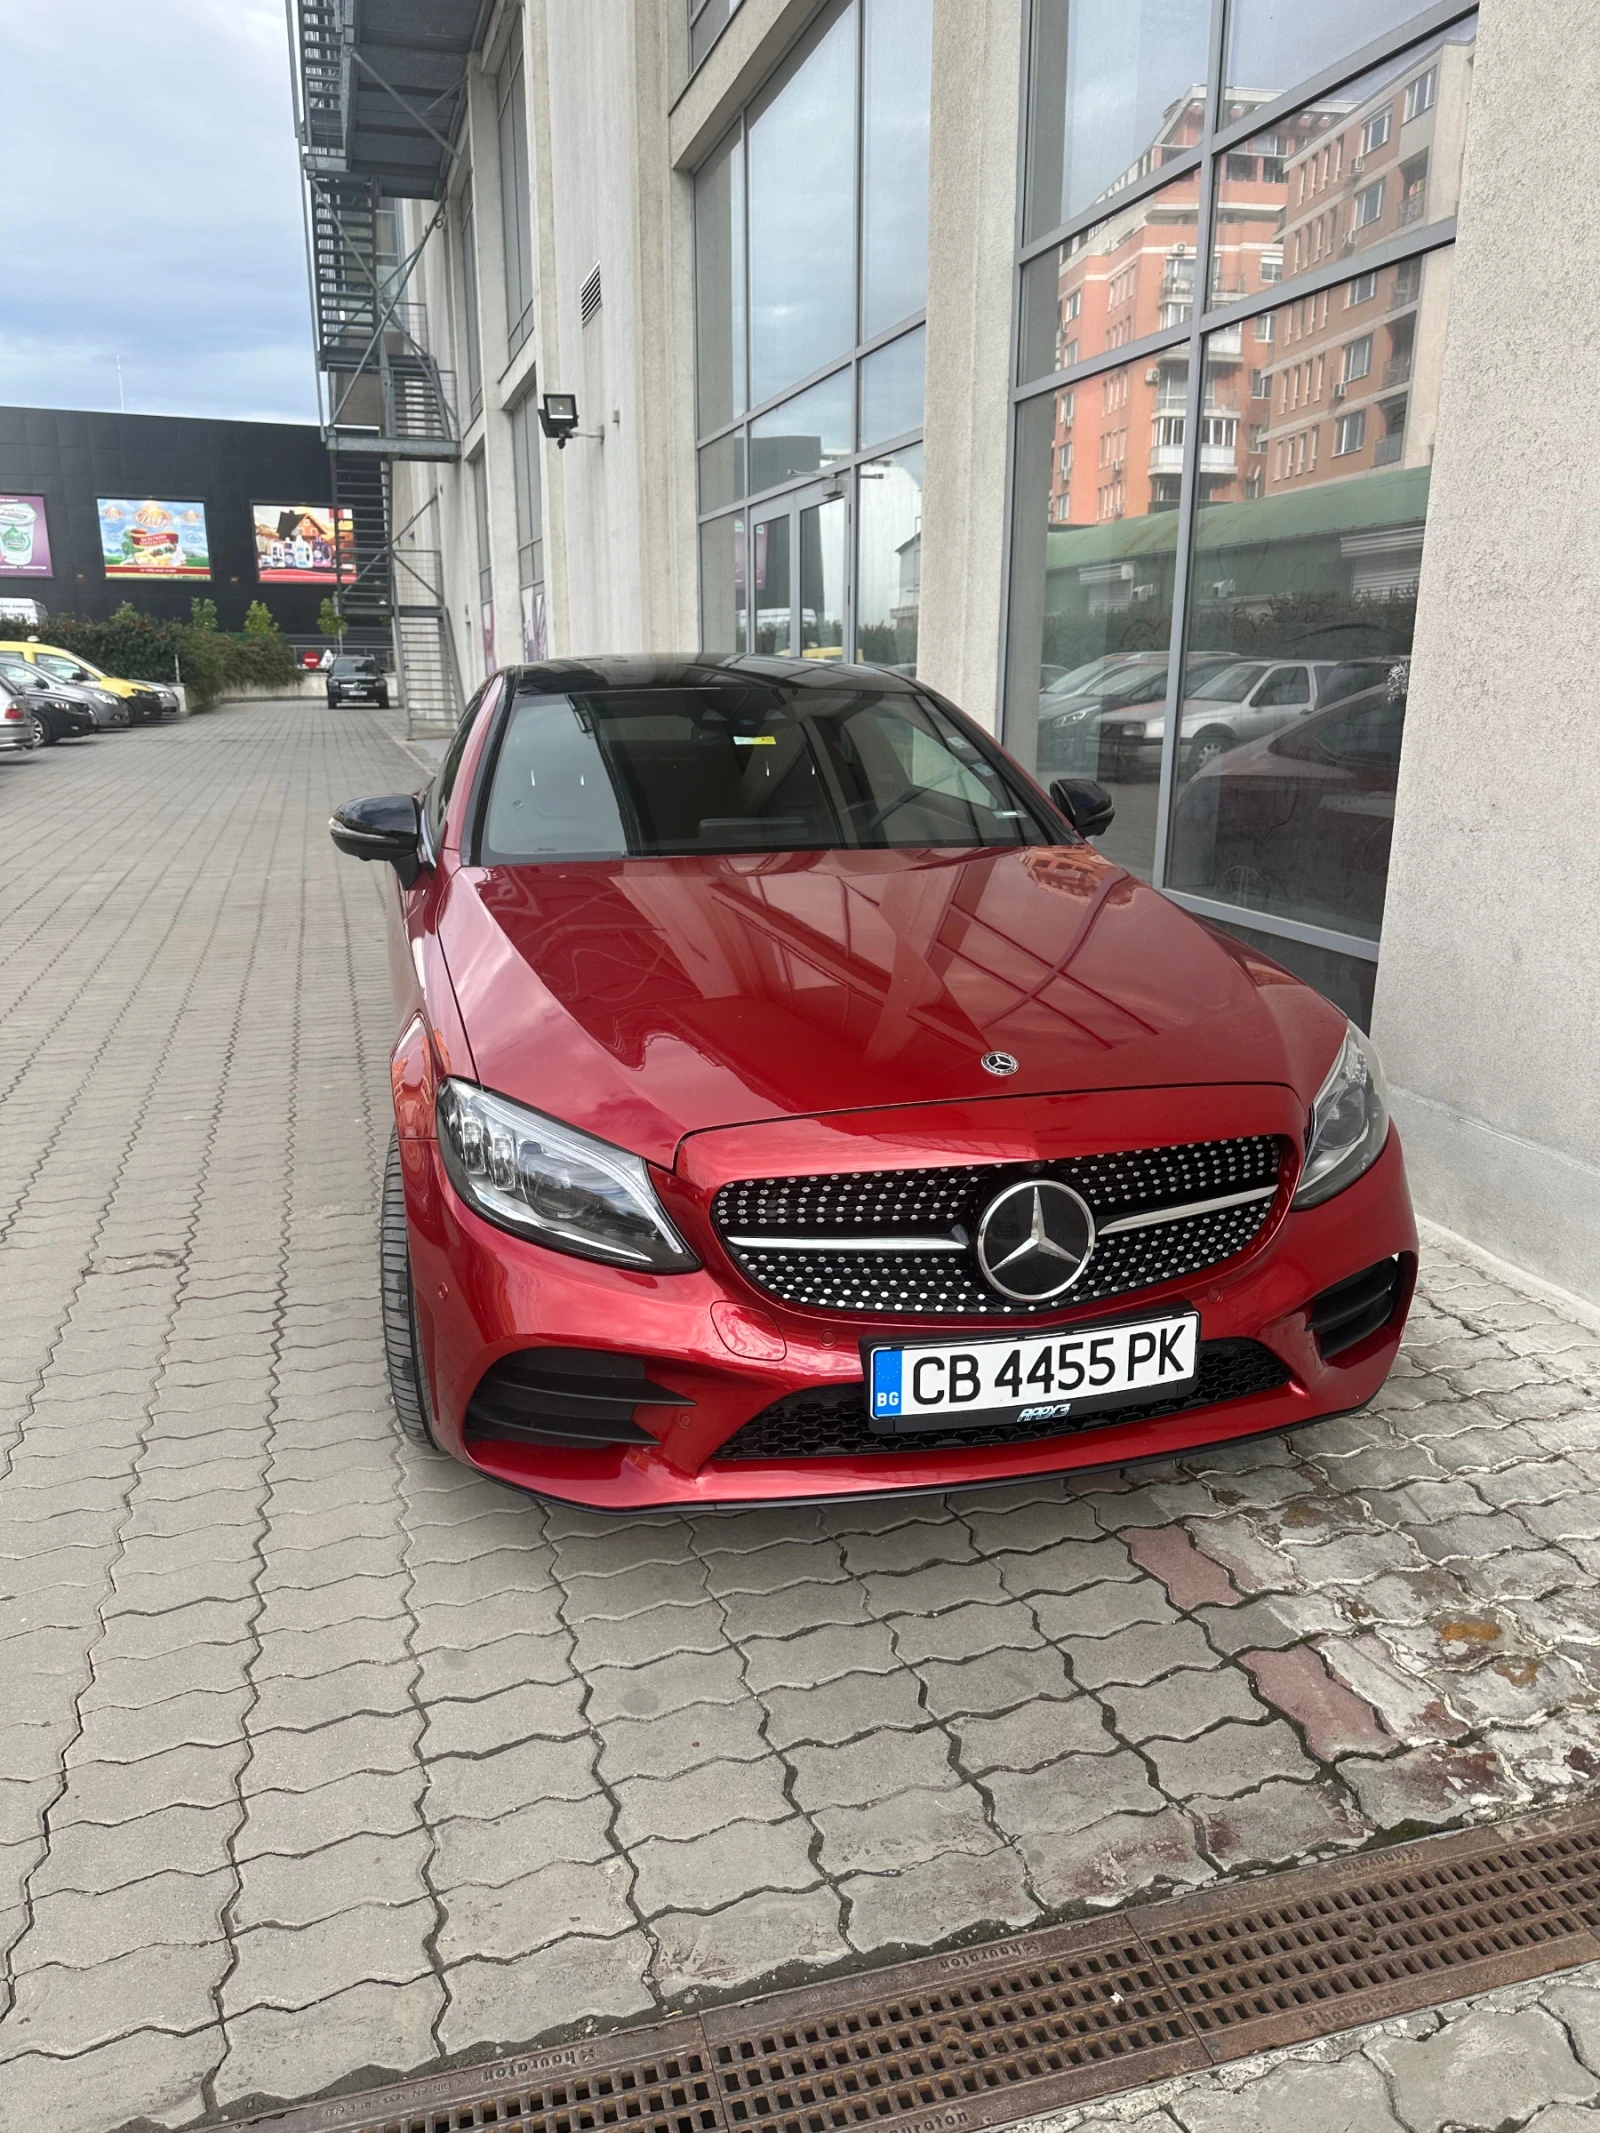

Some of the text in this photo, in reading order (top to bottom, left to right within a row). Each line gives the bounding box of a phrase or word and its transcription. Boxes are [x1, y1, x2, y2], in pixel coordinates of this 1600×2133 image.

[912, 1324, 1187, 1405] CB 4455 PK
[876, 1391, 899, 1407] BG
[940, 1943, 1022, 1970] hauraton
[482, 2049, 576, 2082] hauraton
